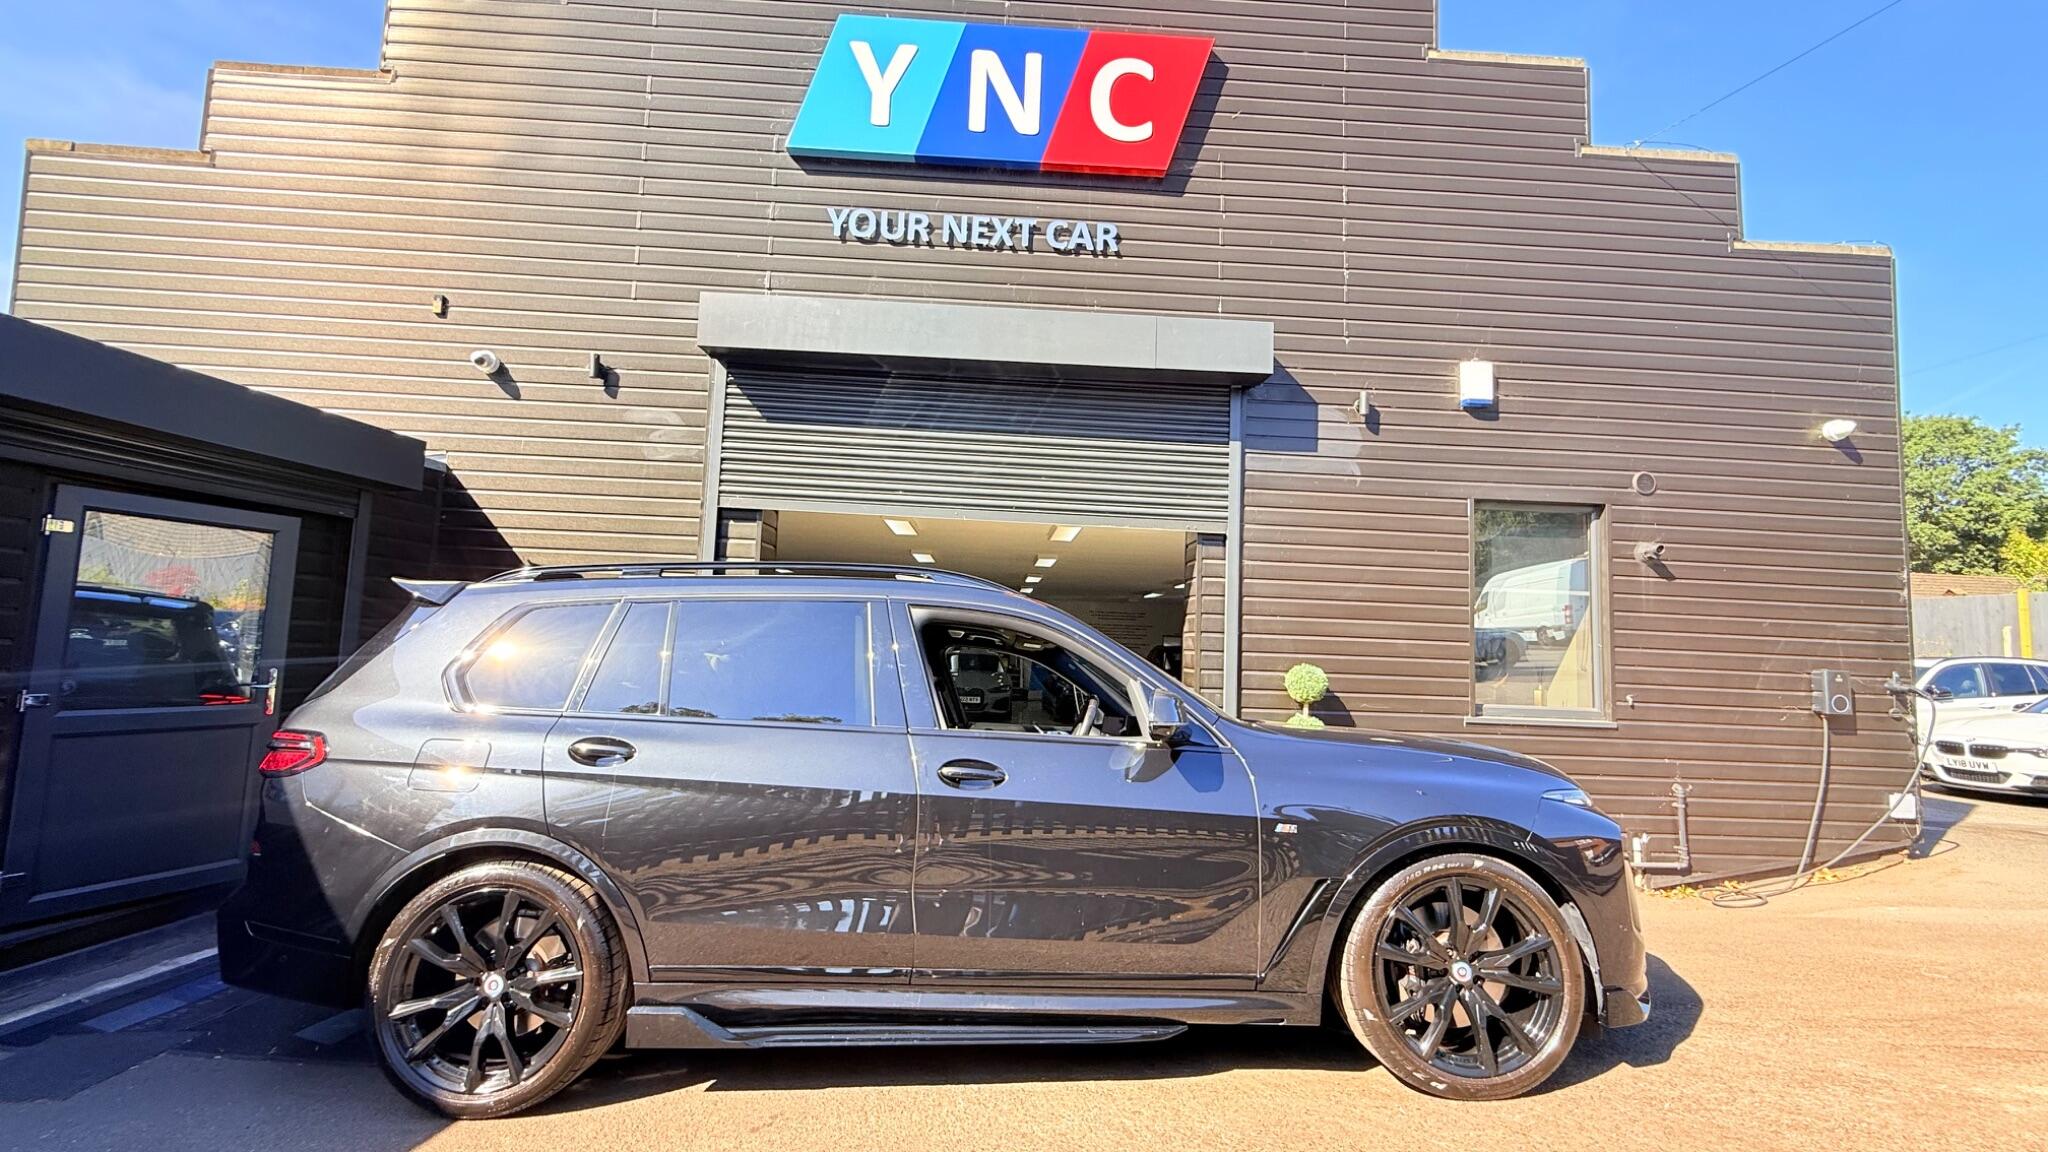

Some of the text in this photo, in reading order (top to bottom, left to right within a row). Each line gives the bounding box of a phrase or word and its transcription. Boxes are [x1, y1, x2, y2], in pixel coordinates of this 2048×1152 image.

[849, 40, 1155, 143] YNC
[826, 207, 1120, 253] YOUR NEXT CAR
